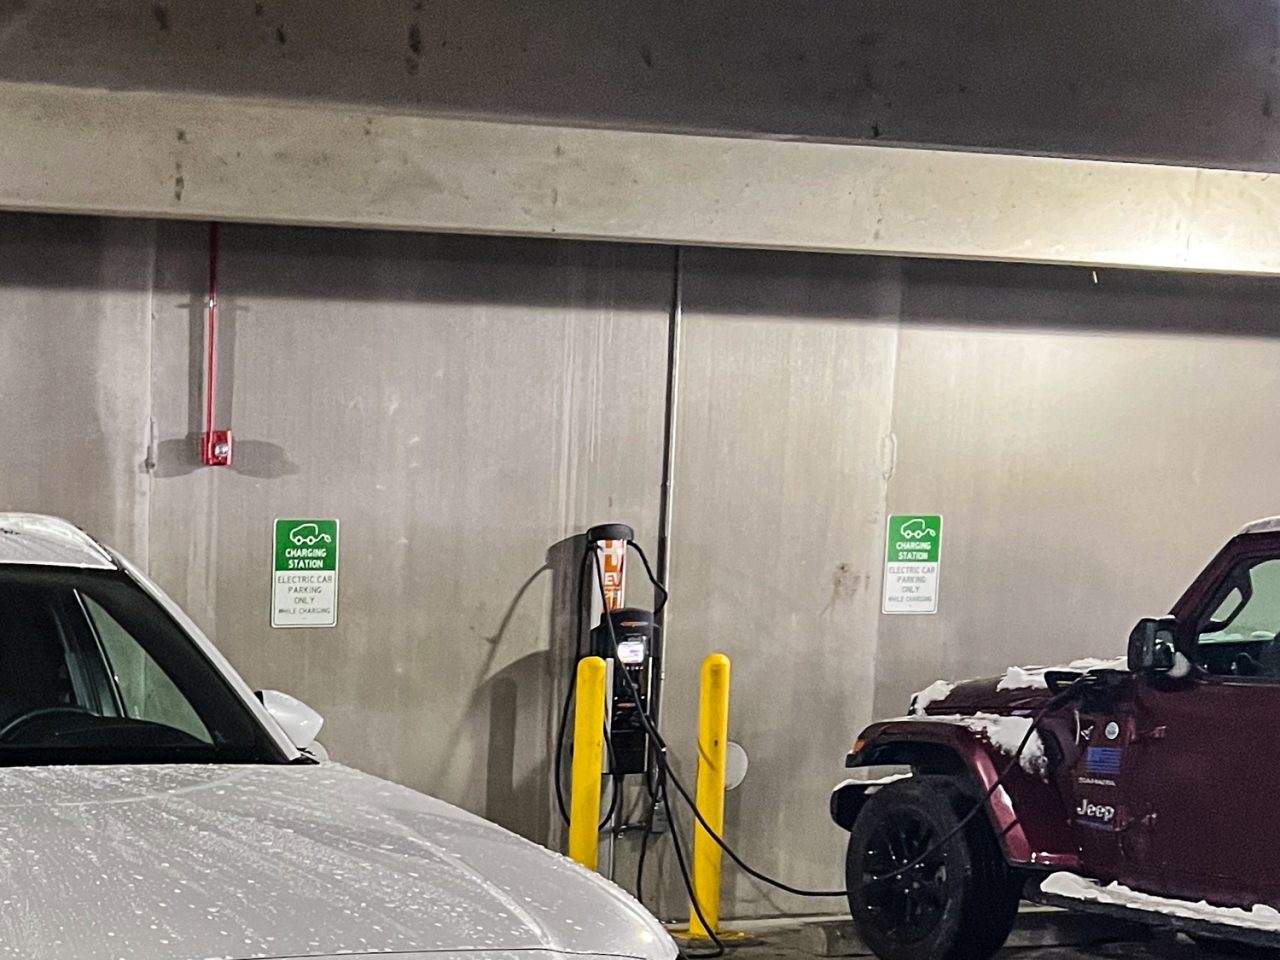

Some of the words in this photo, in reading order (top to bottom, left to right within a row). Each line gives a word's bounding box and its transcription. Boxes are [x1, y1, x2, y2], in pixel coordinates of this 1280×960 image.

[896, 541, 931, 550] CHARGING
[285, 548, 327, 558] CHARGING
[898, 551, 928, 560] STATION
[288, 559, 324, 568] STATION
[888, 566, 920, 574] ELECTRIC
[921, 566, 935, 574] CAR
[277, 575, 315, 584] ELECTRIC
[316, 575, 332, 583] CAR
[896, 575, 927, 584] PARKING
[287, 586, 322, 594] PARKING
[901, 585, 920, 593] ONLY
[294, 596, 315, 605] ONLY
[278, 607, 297, 615] WHILE
[1076, 799, 1115, 821] Jeep
